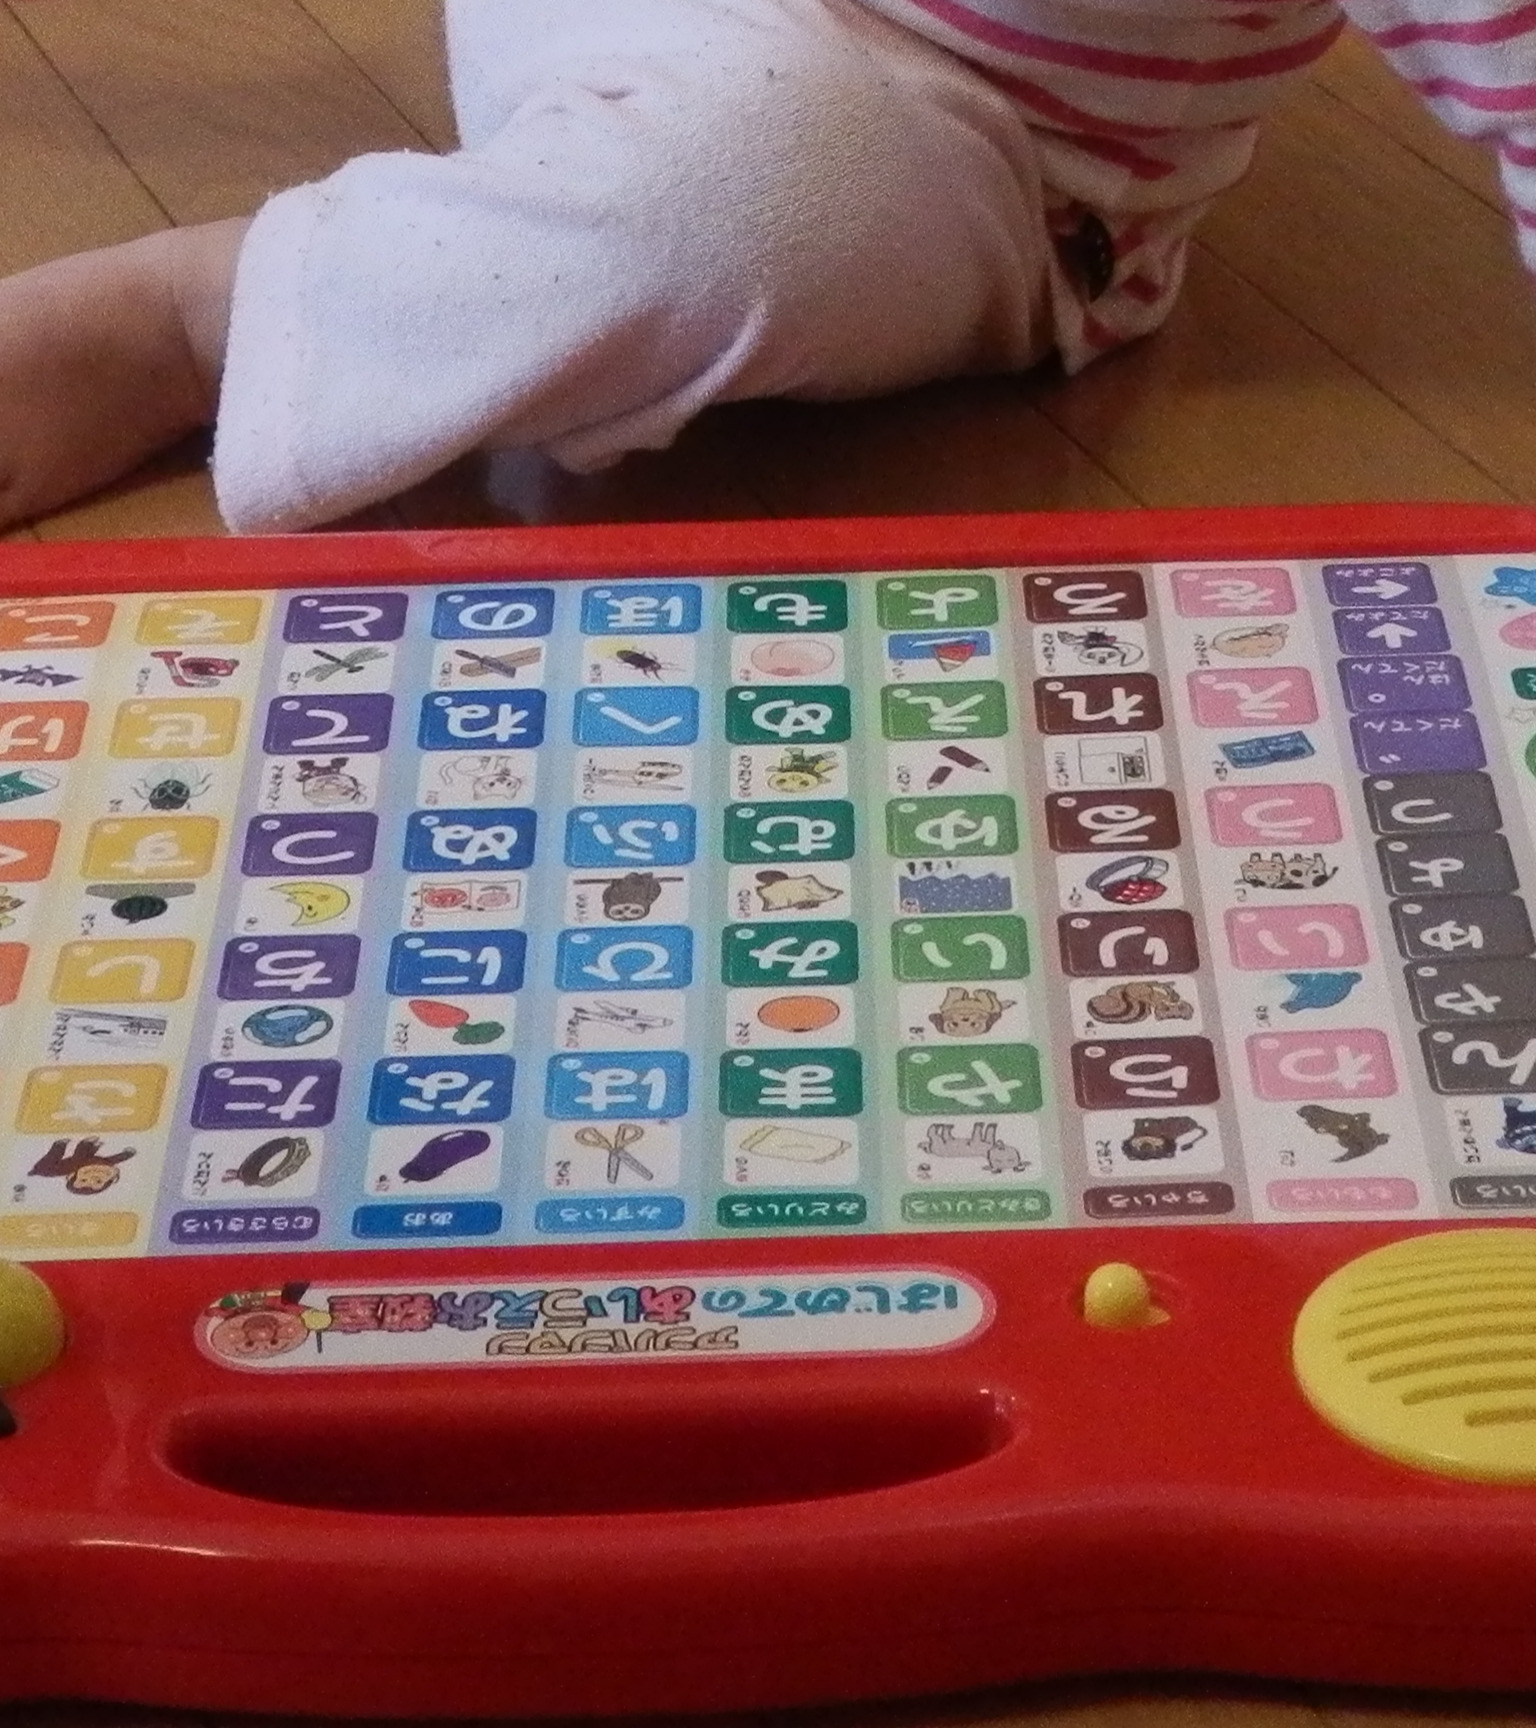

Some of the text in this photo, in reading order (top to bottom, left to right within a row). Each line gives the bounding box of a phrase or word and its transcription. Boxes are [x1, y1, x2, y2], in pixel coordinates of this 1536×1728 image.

[607, 596, 682, 627] ほ
[754, 593, 826, 624] も
[909, 587, 978, 619] よ
[1053, 583, 1125, 614] ろ
[1201, 578, 1274, 610] を
[23, 613, 90, 642] こ
[164, 608, 239, 640] そ
[319, 605, 382, 636] と
[458, 601, 536, 630] の
[752, 699, 831, 731] め
[906, 694, 984, 726] え
[1058, 687, 1143, 720] れ
[1212, 680, 1291, 716] え
[137, 712, 219, 750] せ
[291, 709, 369, 745] て
[445, 704, 527, 740] ね
[600, 706, 681, 733] へ
[751, 815, 835, 854] む
[915, 809, 997, 850] ゆ
[1078, 805, 1155, 843] る
[1241, 798, 1313, 838] う
[111, 830, 194, 875] す
[272, 830, 354, 864] つ
[431, 824, 517, 864] ぬ
[592, 819, 678, 859] ふ
[749, 937, 839, 977] み
[921, 931, 1005, 969] い
[1099, 926, 1168, 967] り
[1257, 921, 1343, 957] い
[86, 953, 161, 998] し
[253, 950, 331, 991] ち
[420, 946, 501, 985] に
[582, 941, 672, 981] ひ
[926, 1059, 1021, 1106] や
[1109, 1053, 1186, 1097] ら
[1278, 1045, 1374, 1090] わ
[51, 1079, 136, 1127] さ
[225, 1076, 318, 1120] た
[400, 1071, 493, 1115] な
[575, 1067, 666, 1111] は
[758, 1064, 835, 1109] ま
[558, 1205, 660, 1221] みずいろ
[730, 1201, 858, 1217] みどりいろ
[1107, 1188, 1207, 1206] ちゃいろ
[181, 1214, 312, 1232] むらさきいろ
[402, 1211, 452, 1227] あお
[485, 1325, 737, 1355] アンパンマン
